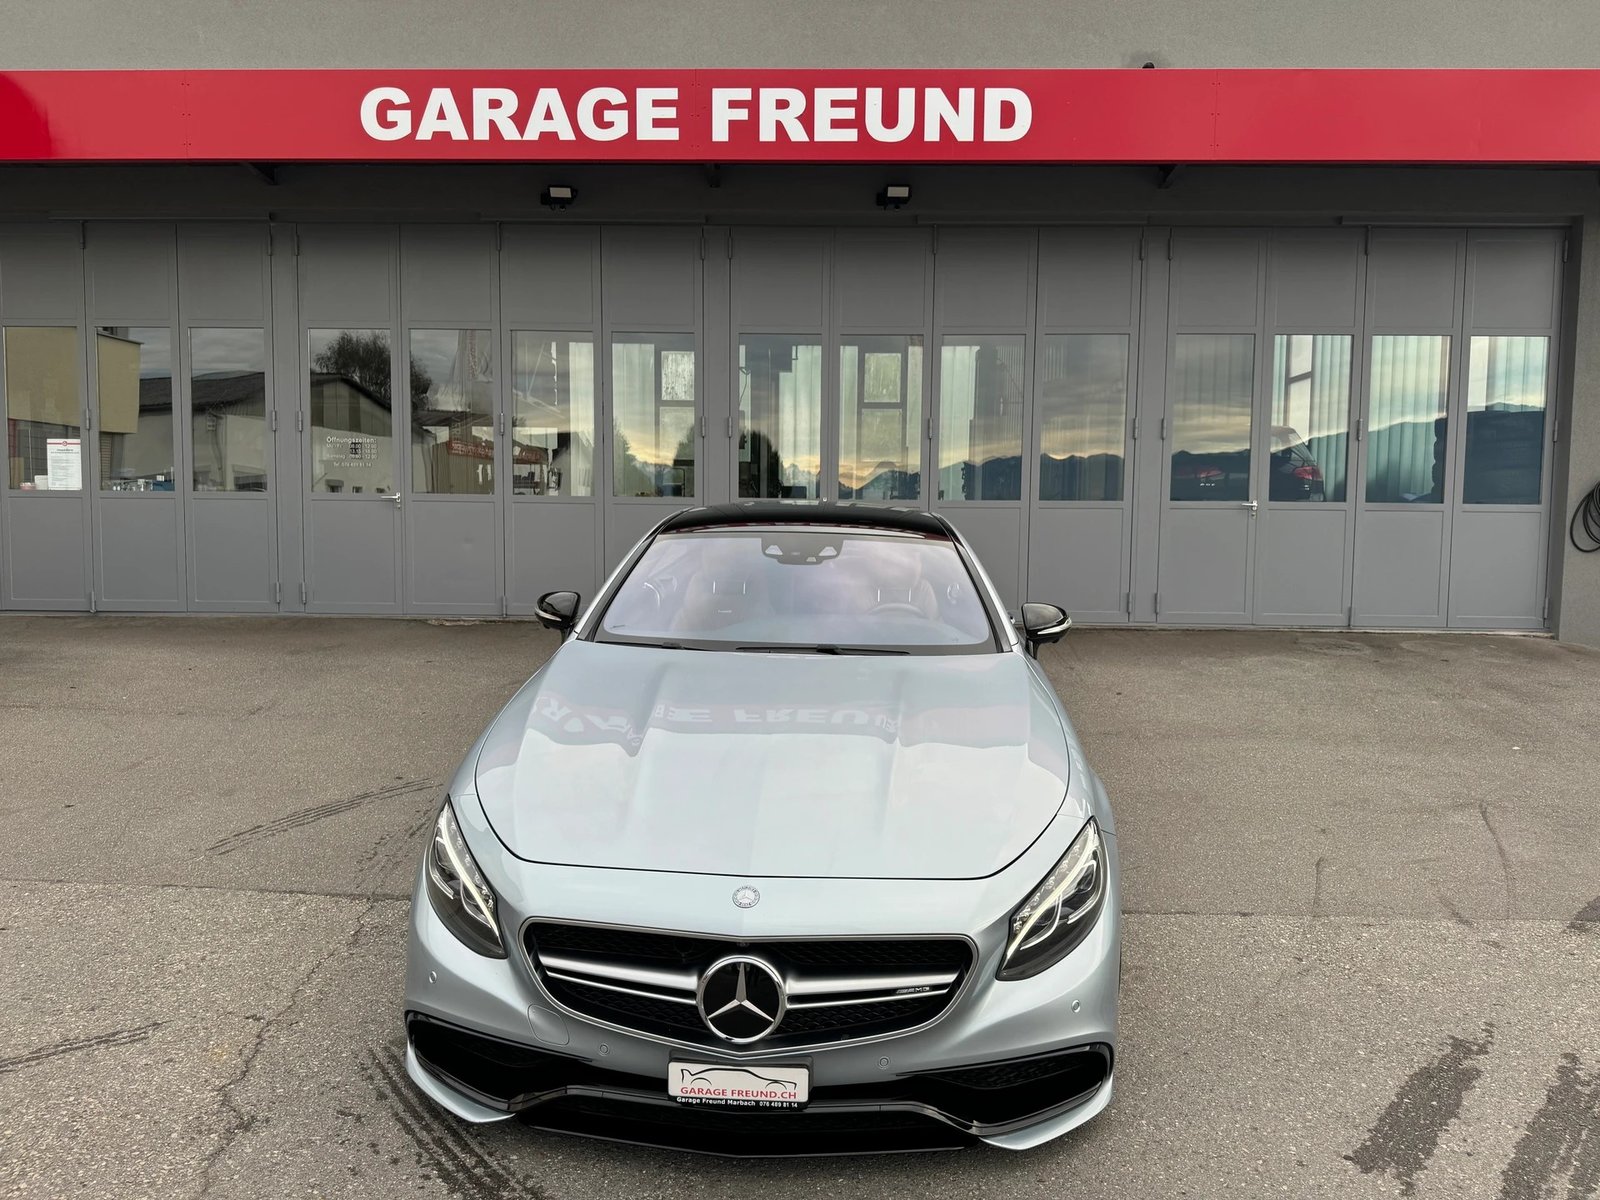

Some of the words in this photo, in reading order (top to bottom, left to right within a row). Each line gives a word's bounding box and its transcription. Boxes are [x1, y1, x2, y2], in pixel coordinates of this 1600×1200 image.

[360, 87, 680, 142] GARAGE
[711, 87, 1032, 143] FREUND
[680, 1087, 727, 1097] GARAGE
[731, 1089, 797, 1099] FREUND.CH
[676, 1096, 701, 1105] Garage
